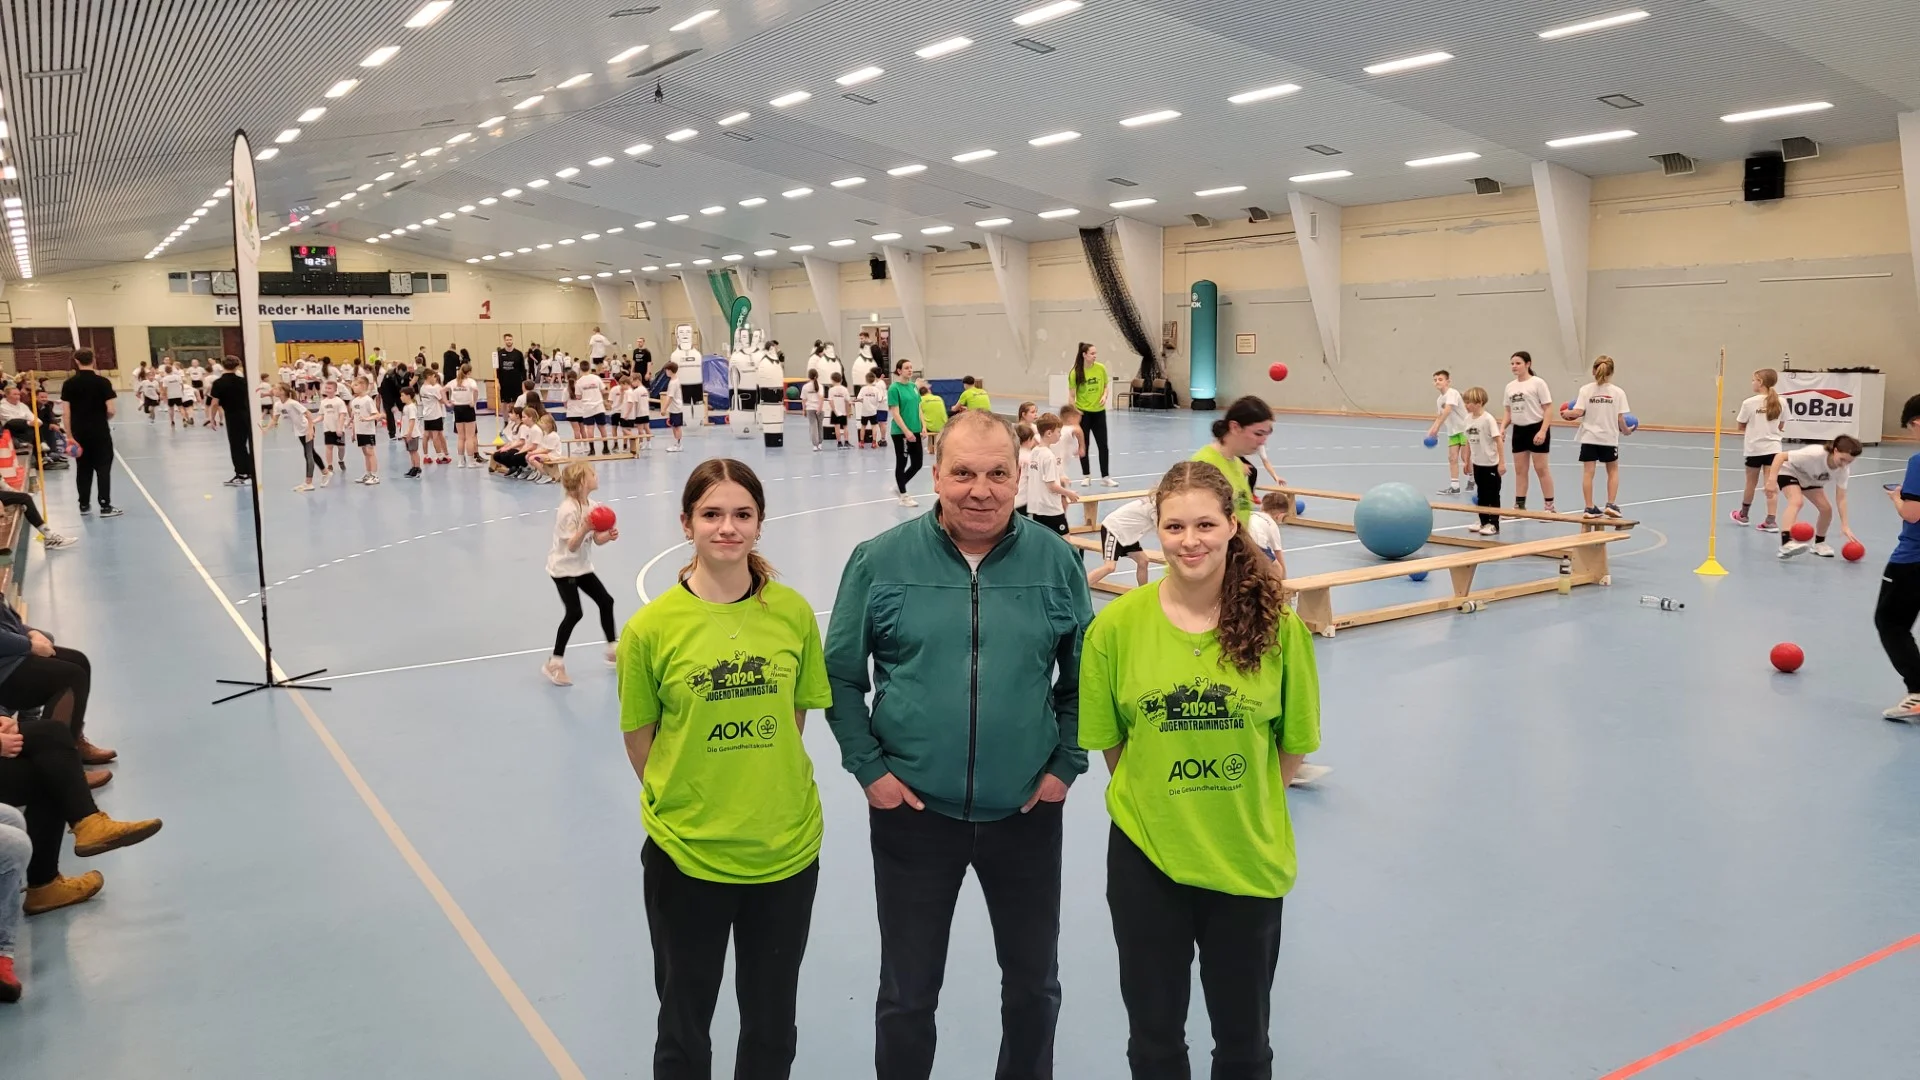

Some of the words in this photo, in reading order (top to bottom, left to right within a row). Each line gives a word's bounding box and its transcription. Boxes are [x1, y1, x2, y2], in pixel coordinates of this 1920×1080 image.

[258, 304, 298, 315] Reder
[306, 304, 340, 315] Halle
[344, 304, 410, 315] Marienehe
[479, 300, 491, 320] 1
[705, 685, 778, 701] JUGENDTRAININGSTAG
[707, 720, 754, 741] AOK
[1159, 718, 1244, 732] JUGENDTRAININGSTAG
[1167, 758, 1220, 782] AOK
[1169, 787, 1181, 796] Die
